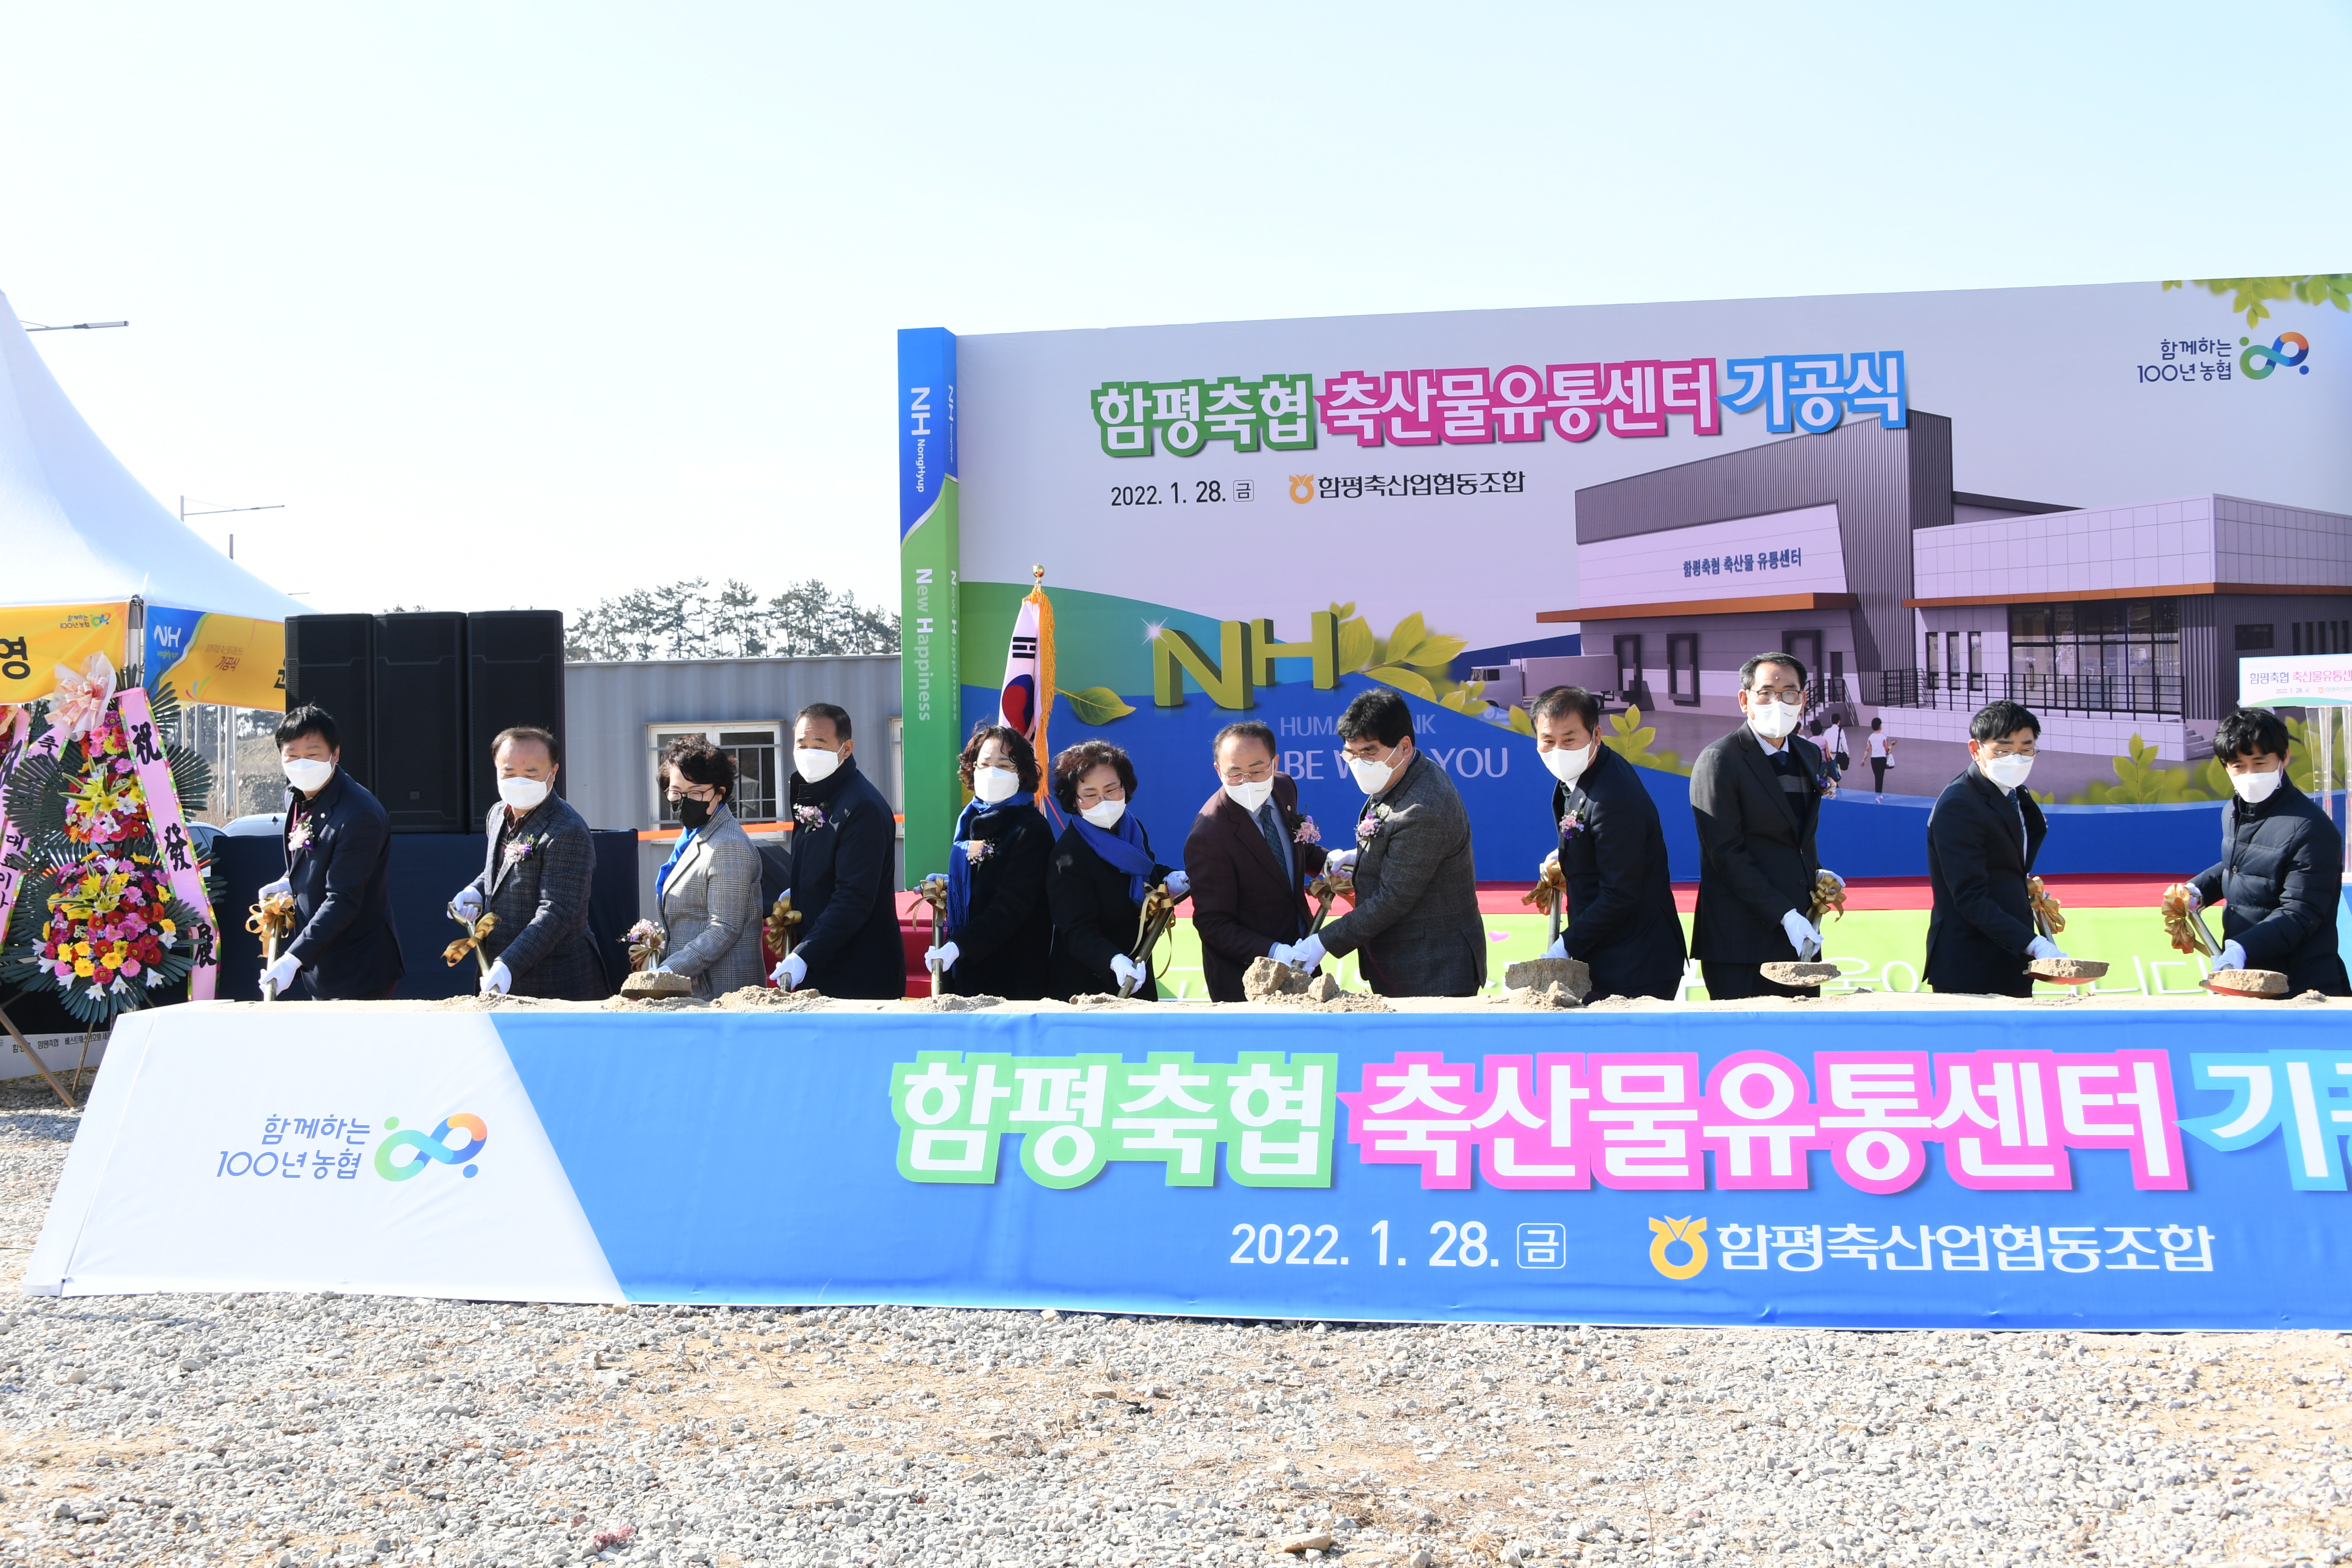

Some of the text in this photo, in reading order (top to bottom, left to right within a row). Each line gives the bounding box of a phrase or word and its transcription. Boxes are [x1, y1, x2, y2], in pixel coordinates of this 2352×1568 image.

[2160, 337, 2232, 361] 함께하는
[2137, 359, 2232, 384] 100년 농협
[911, 387, 931, 436] NH
[1097, 357, 1898, 450] 함평축협 축산물유통센터 기공식
[915, 438, 926, 493] NongHyup
[1111, 485, 1162, 506] 2022.
[1171, 482, 1187, 504] 1.
[1196, 481, 1226, 502] 28.
[1318, 471, 1526, 499] 함평축산업협동조합
[1682, 547, 1802, 577] 함평축협 축산물 유통센터
[154, 625, 182, 648] NH
[914, 568, 934, 721] New Happiness
[215, 656, 240, 672] 기공식
[1152, 610, 1339, 710] NH
[2250, 672, 2289, 684] 함평축협
[1280, 715, 1340, 736] HUM
[1285, 749, 1324, 780] BE
[1429, 747, 1508, 778] YOU
[261, 1113, 371, 1145] 함께하는
[903, 1062, 1324, 1177] 함평축협
[1362, 1062, 2170, 1181] 축산물유통센터
[216, 1148, 362, 1180] 100년 농협
[1230, 1223, 1349, 1265] 2022.
[1371, 1220, 1406, 1266] 1.
[1428, 1220, 1499, 1267] 28.
[1716, 1223, 2216, 1273] 함평축산업협동조합
